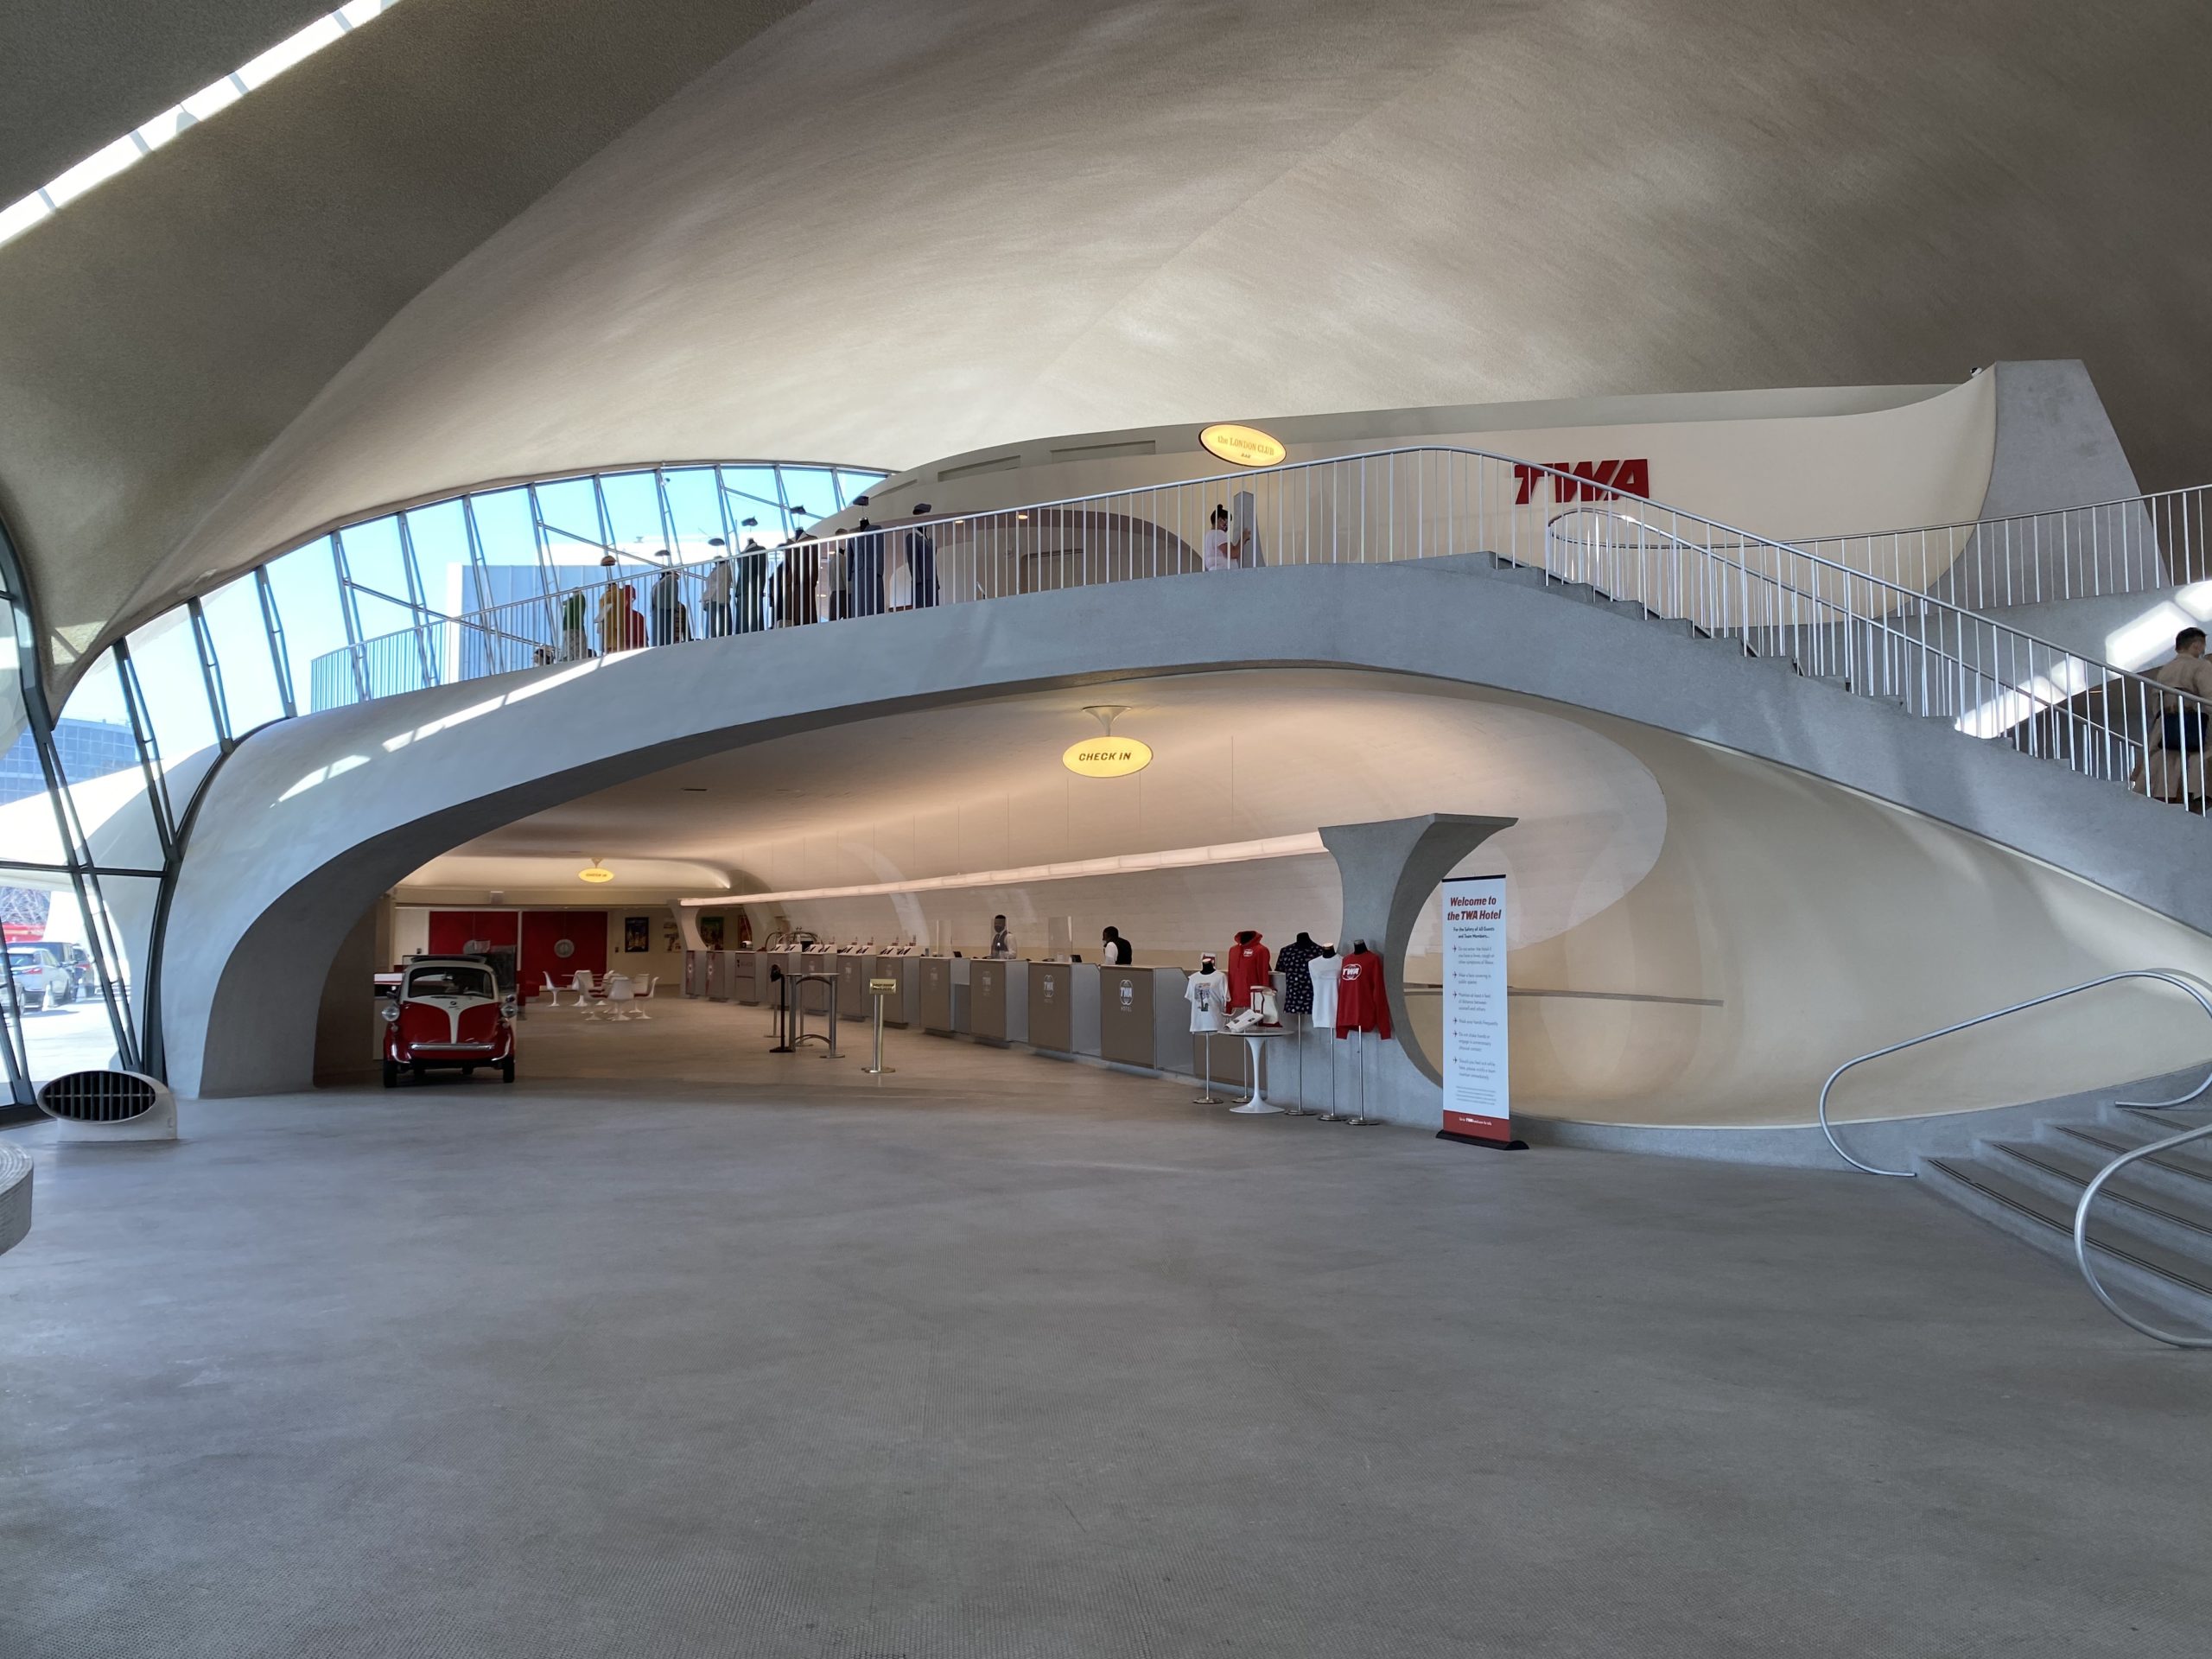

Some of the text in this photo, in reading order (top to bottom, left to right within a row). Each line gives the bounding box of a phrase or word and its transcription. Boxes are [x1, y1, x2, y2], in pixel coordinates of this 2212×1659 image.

[1217, 435, 1274, 456] the LONDON CLUB
[1515, 459, 1649, 505] TWA
[1078, 752, 1132, 761] CHECK IN
[1450, 895, 1497, 906] Welcome to
[1447, 909, 1502, 921] the TWA Hotel
[1343, 967, 1359, 976] TWA
[1121, 987, 1132, 998] TWA
